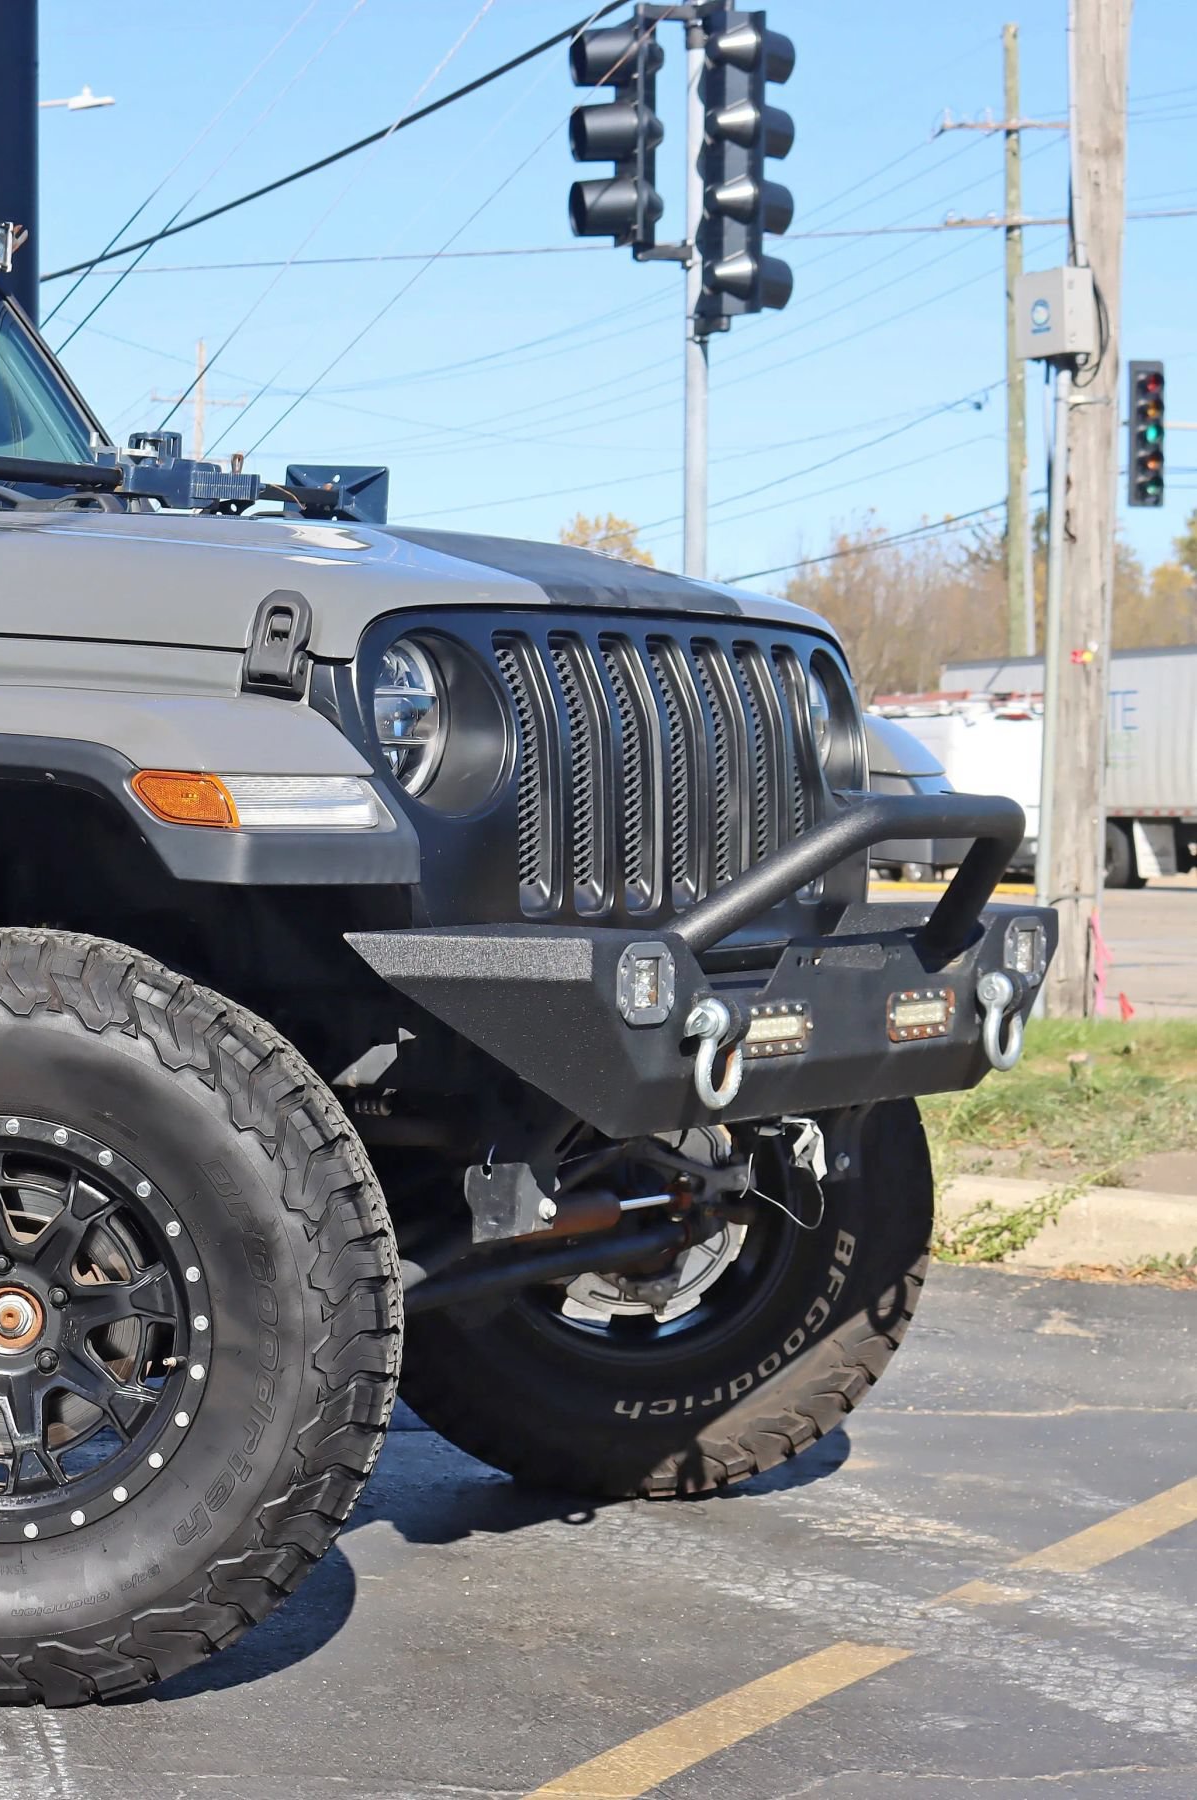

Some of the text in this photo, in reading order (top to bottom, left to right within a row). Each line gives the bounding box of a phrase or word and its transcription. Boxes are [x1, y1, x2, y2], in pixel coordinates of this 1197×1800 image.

[172, 1158, 281, 1547] BFGoodrich
[613, 1228, 857, 1421] BFGoodrich
[10, 1564, 161, 1617] Baja Champion
